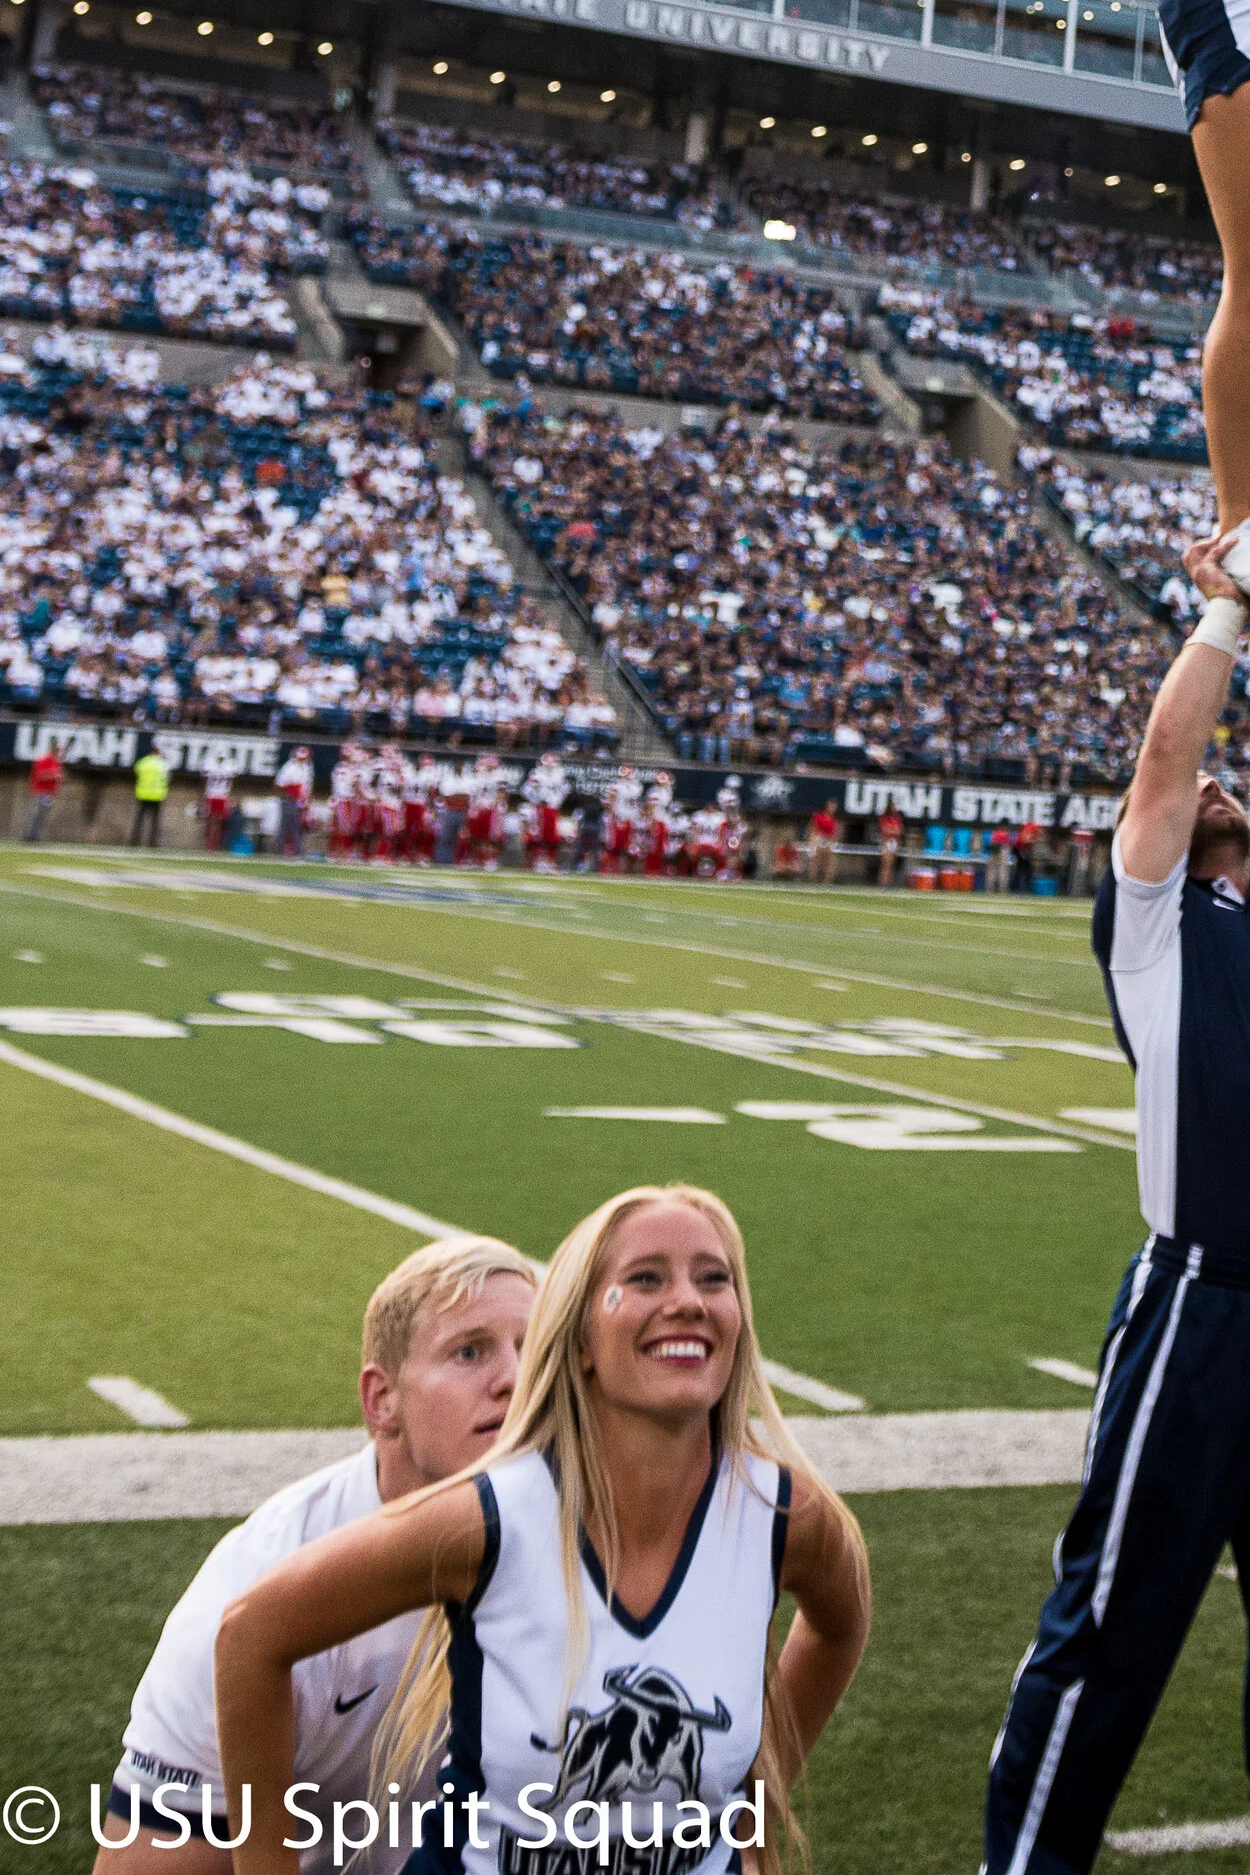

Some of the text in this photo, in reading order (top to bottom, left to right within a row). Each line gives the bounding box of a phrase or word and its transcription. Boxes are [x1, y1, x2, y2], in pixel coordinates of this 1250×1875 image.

[626, 4, 892, 73] UNIVERSITY
[13, 721, 138, 768] UTAH
[843, 778, 943, 820] UTAH
[951, 787, 1056, 825] STATE
